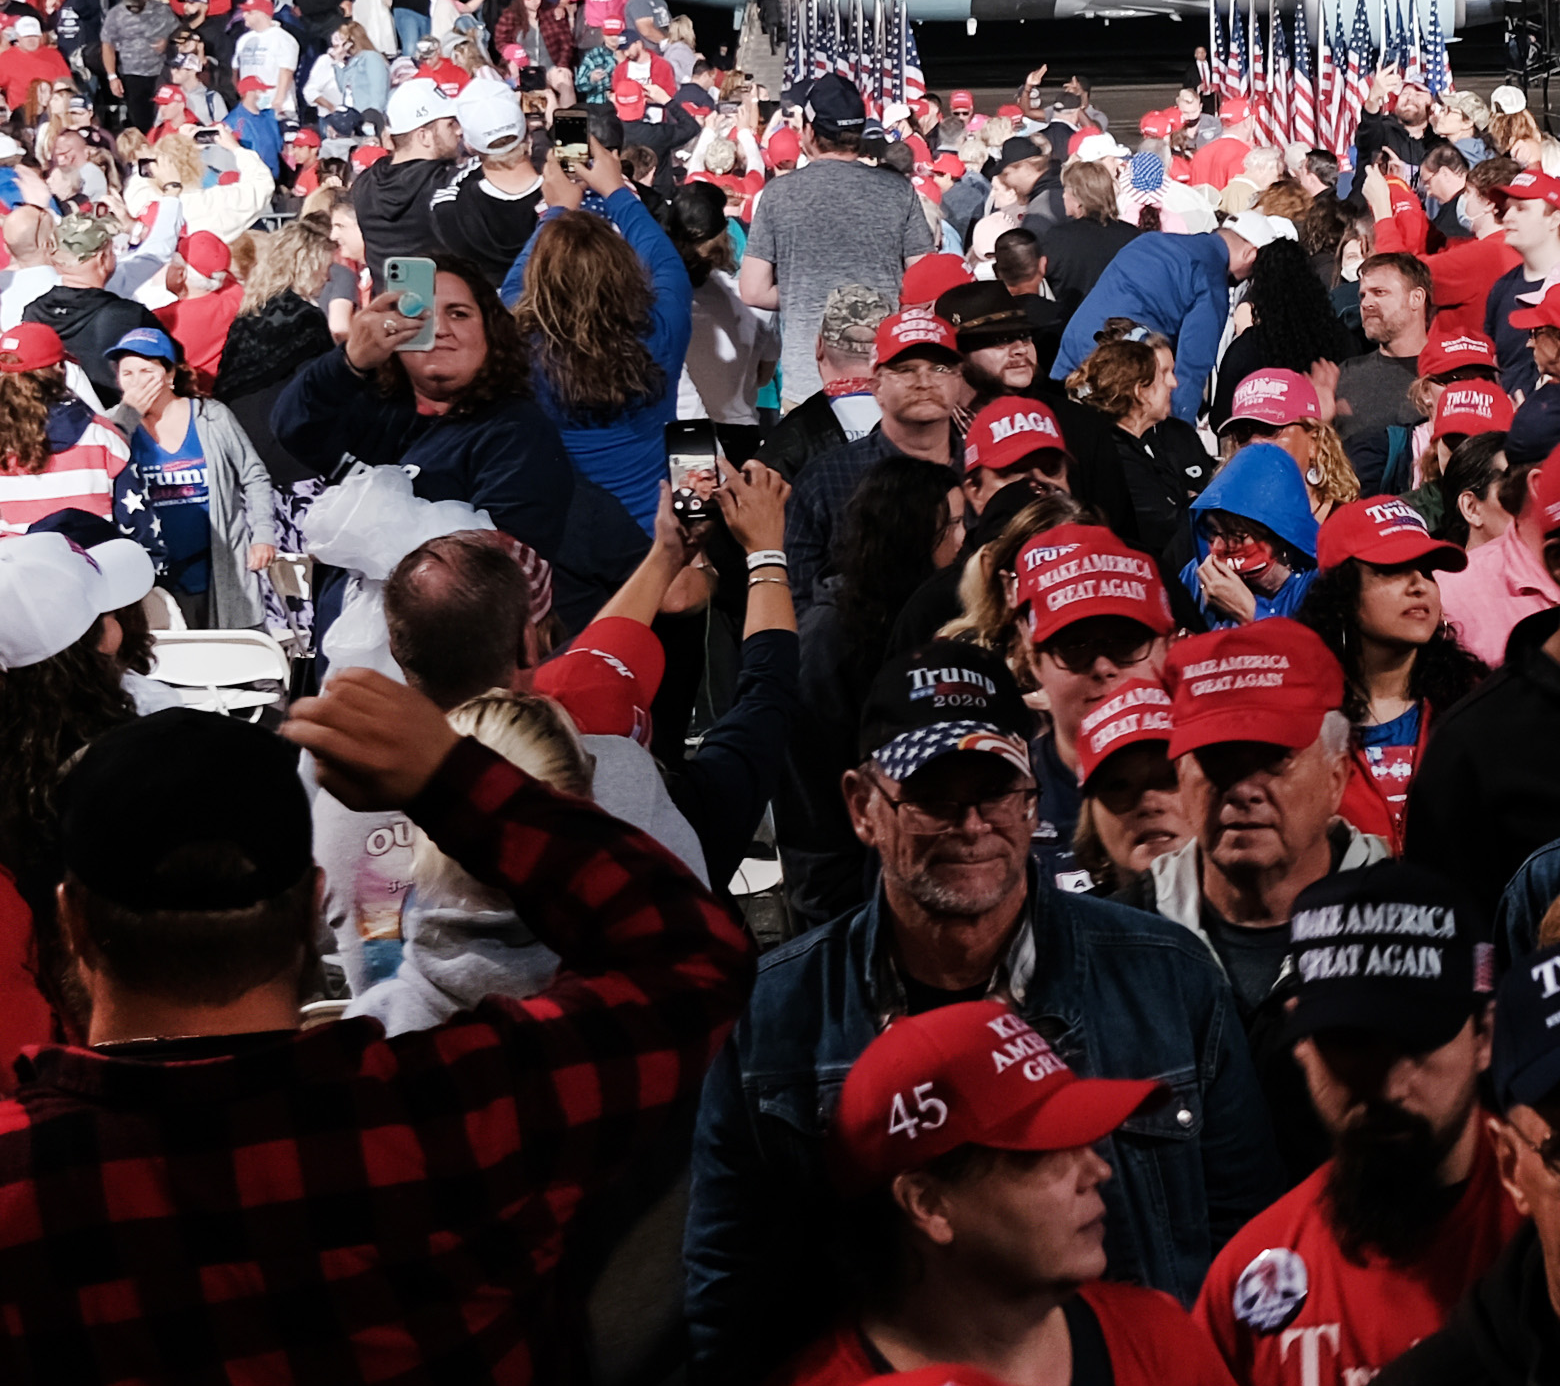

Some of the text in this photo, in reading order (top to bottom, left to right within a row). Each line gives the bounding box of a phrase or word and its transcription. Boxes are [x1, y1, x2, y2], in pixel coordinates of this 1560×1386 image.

[989, 412, 1060, 445] MAGA
[1037, 552, 1154, 593] MAKE AMERICA
[1047, 579, 1147, 611] GREAT AGAIN
[905, 667, 997, 695] Trump
[1182, 654, 1291, 680] MAKE AMERICA
[1190, 672, 1284, 697] GREAT AGAIN
[932, 693, 988, 710] 2020
[1290, 902, 1457, 944] MAKE AMERICA
[1298, 945, 1443, 984] GREAT AGAIN
[888, 1082, 949, 1142] 45
